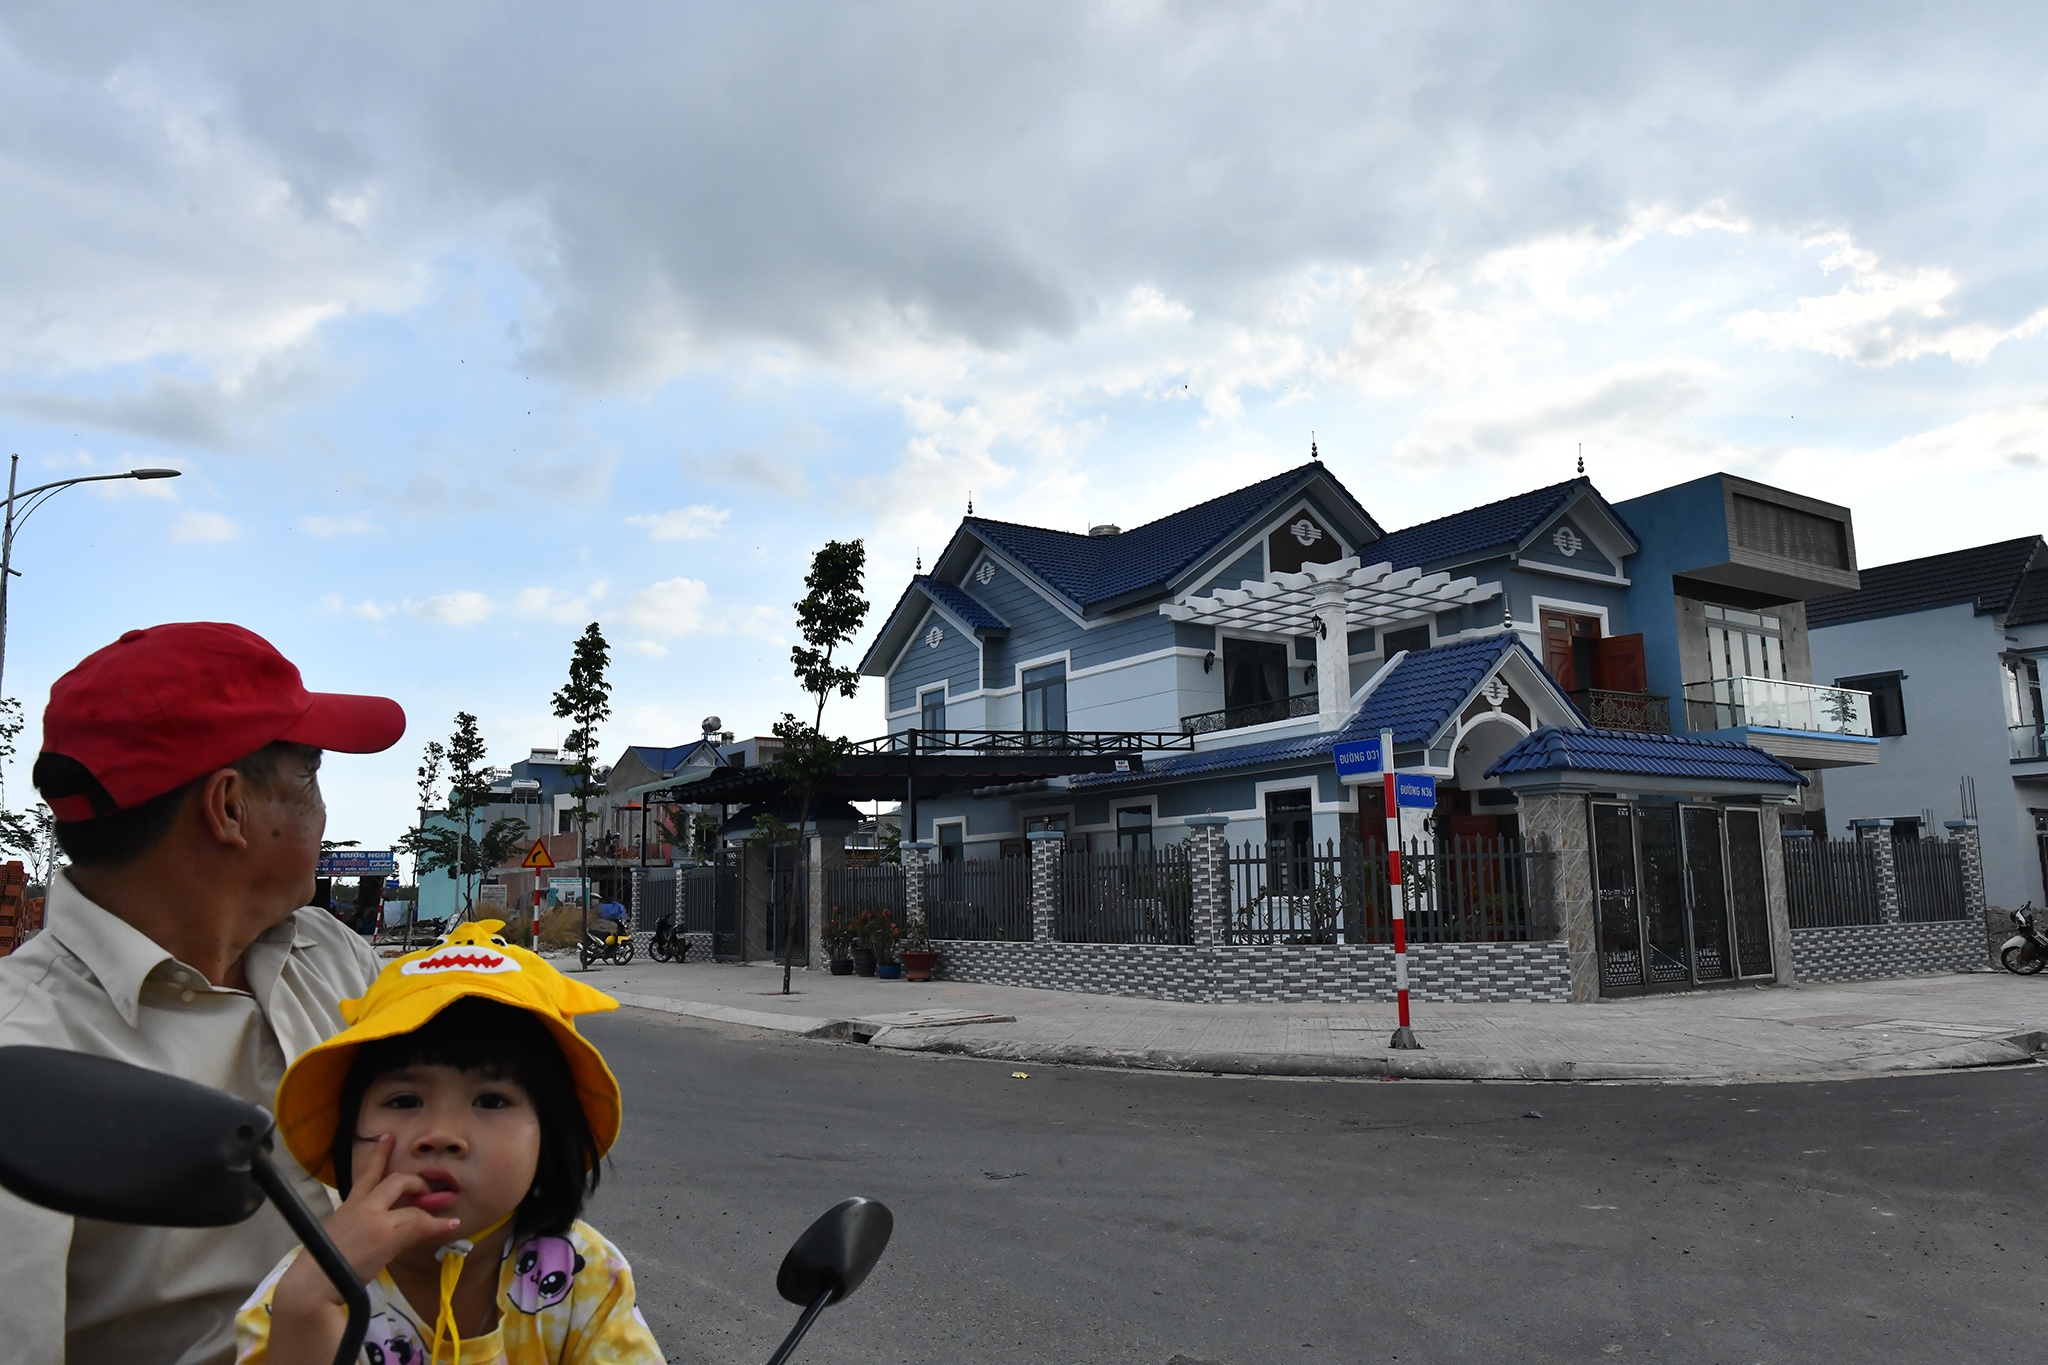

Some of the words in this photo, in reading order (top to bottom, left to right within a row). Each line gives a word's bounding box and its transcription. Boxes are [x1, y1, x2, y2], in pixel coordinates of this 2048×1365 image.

[1339, 751, 1365, 764] ĐƯỜNG
[1366, 749, 1380, 761] D31
[1400, 783, 1420, 796] ĐƯỜNG
[1421, 786, 1433, 797] N36
